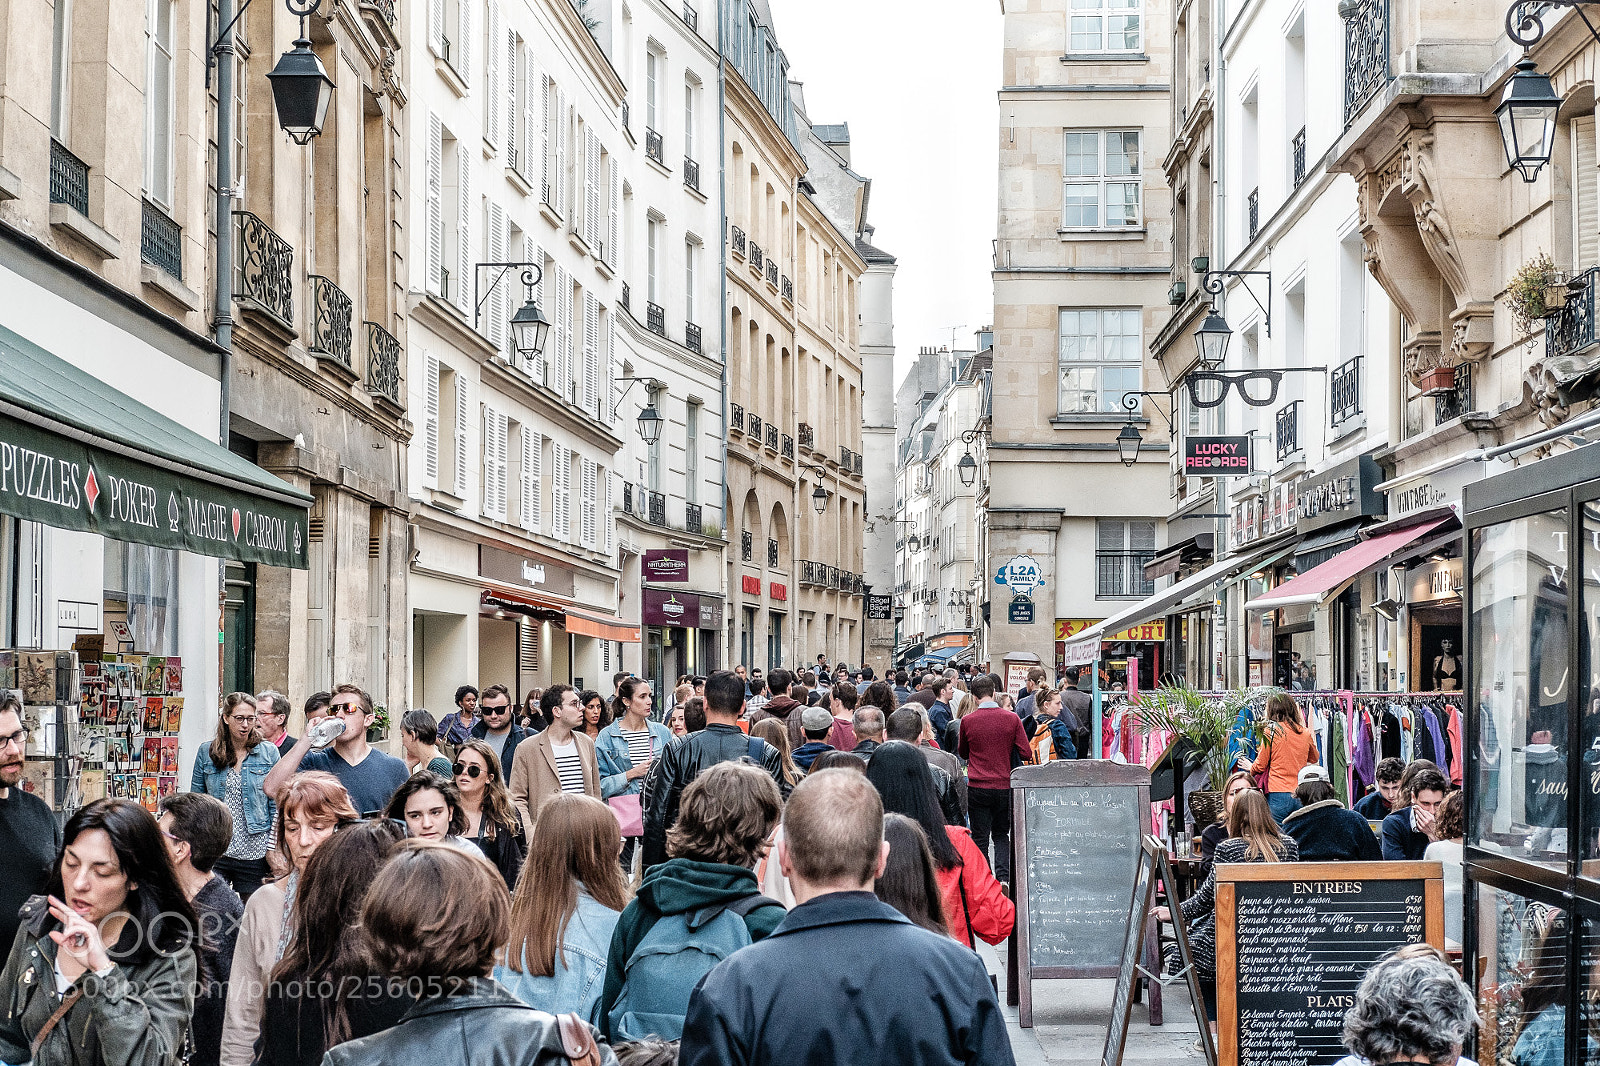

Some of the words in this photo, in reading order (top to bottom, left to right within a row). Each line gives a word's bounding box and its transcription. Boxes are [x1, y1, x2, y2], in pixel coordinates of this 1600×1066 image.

[1195, 443, 1239, 455] LUCKY
[0, 442, 80, 510] PUZZLES
[108, 475, 159, 529] POKER
[187, 496, 228, 542] MAGIE
[245, 510, 288, 553] CARROM
[1010, 565, 1036, 576] L2A
[1292, 882, 1362, 894] ENTREES
[1239, 895, 1261, 906] Soupe
[1262, 896, 1273, 905] du
[1273, 895, 1292, 906] jour
[1306, 895, 1331, 904] saison
[1238, 905, 1273, 915] Cocktail
[1273, 905, 1282, 914] de
[1238, 915, 1269, 924] Tomate
[1270, 914, 1317, 924] mozzarella
[1238, 925, 1274, 937] Escargots
[1274, 925, 1283, 934] de
[1283, 925, 1327, 937] Bourgogne
[1333, 924, 1344, 933] les
[1372, 923, 1383, 933] les
[1260, 935, 1309, 947] mayonnaise
[1239, 944, 1273, 954] Saumon
[1275, 944, 1308, 953] mariné
[1238, 953, 1277, 966] Carpaccio
[1278, 954, 1289, 963] de
[1239, 964, 1269, 974] Terrine
[1270, 963, 1280, 973] de
[1281, 963, 1296, 975] foie
[1296, 965, 1314, 976] gras
[1314, 963, 1325, 973] de
[1325, 963, 1356, 973] canard
[1239, 973, 1260, 983] Mini
[1261, 973, 1305, 983] camembert
[1240, 983, 1271, 993] Assiette
[1272, 983, 1281, 992] de
[1306, 995, 1354, 1008] PLATS
[1308, 1009, 1334, 1018] tartare
[1334, 1009, 1343, 1018] de
[1314, 1019, 1341, 1028] tartare
[1240, 1028, 1268, 1039] French
[1269, 1028, 1295, 1041] burger
[1240, 1038, 1271, 1048] Chicken
[1271, 1038, 1297, 1051] burger
[1241, 1048, 1269, 1060] Burger
